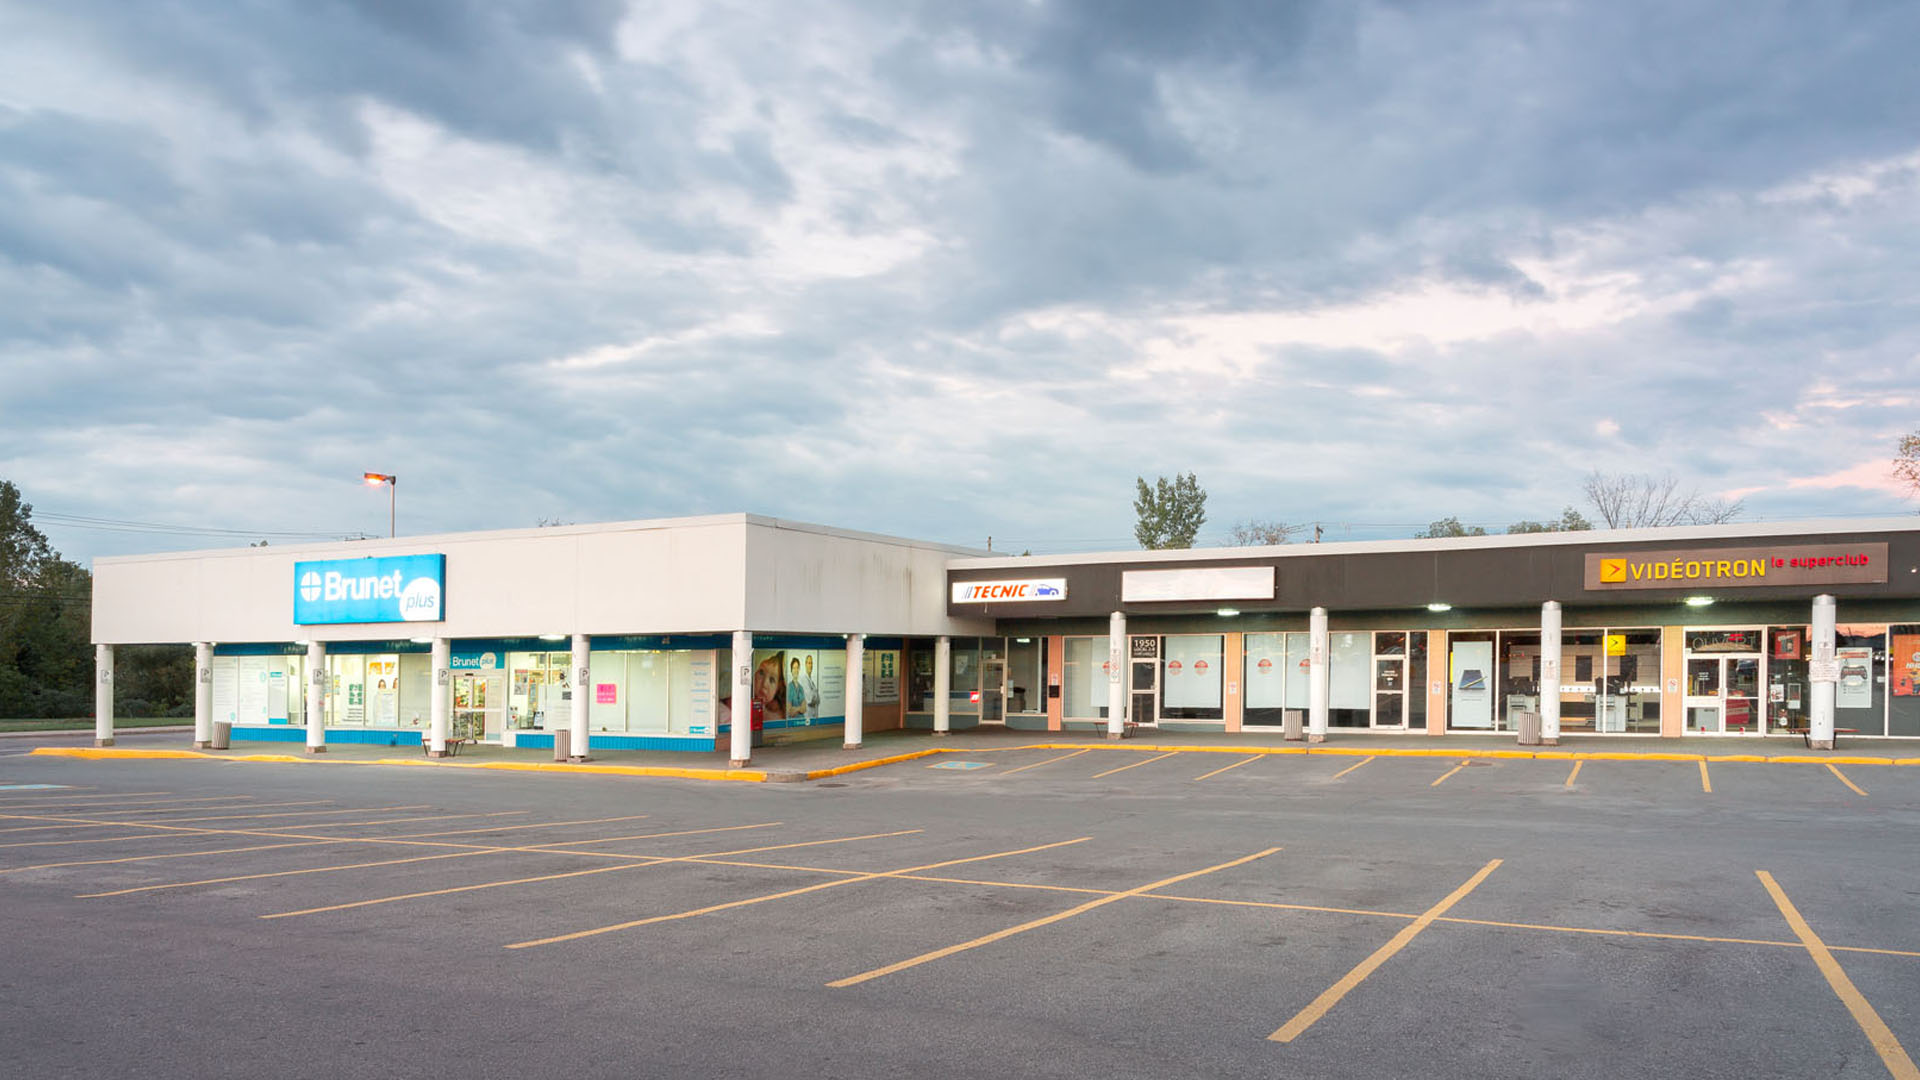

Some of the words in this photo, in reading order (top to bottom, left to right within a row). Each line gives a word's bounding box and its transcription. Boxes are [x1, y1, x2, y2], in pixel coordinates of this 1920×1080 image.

[1630, 558, 1766, 580] VIDÉOTRON
[1771, 556, 1784, 568] le
[1790, 553, 1869, 569] superclub
[324, 569, 403, 601] Brunet
[973, 584, 1030, 599] TECNIC
[406, 592, 435, 611] plus
[1134, 639, 1156, 648] 1950
[452, 656, 479, 666] Brunet
